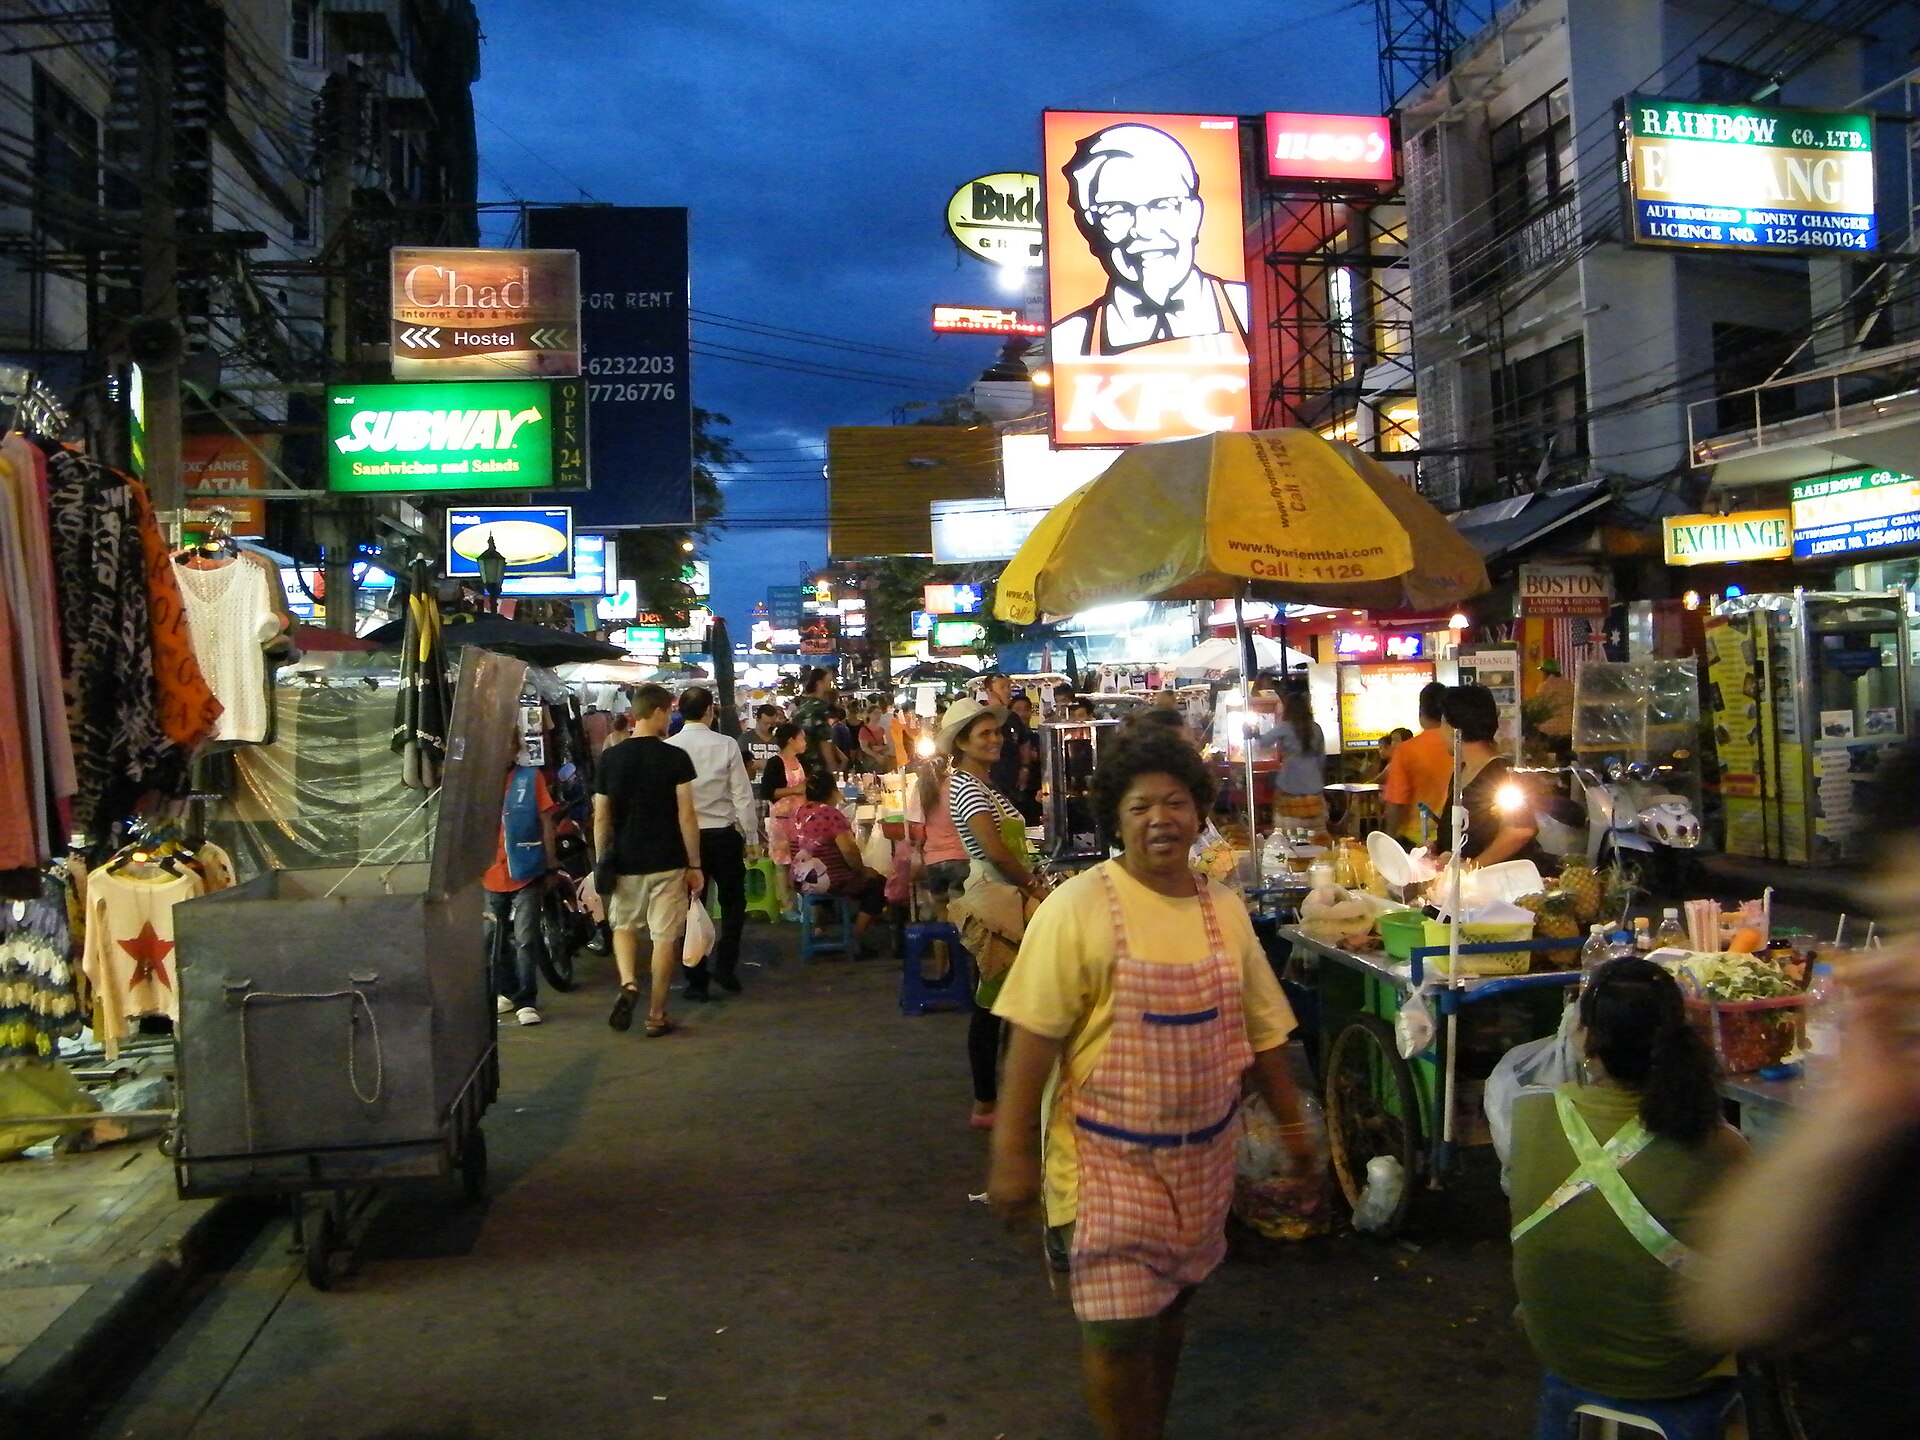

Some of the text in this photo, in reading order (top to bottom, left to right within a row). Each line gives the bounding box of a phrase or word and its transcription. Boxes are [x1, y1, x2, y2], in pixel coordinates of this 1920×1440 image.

[1640, 109, 1778, 143] RAINBOW
[1746, 210, 1797, 226] MONEY
[1801, 214, 1870, 231] CHANGER
[1650, 222, 1867, 249] LICENCE NO. 125480104
[404, 264, 530, 309] Chad
[625, 291, 674, 309] RENT
[401, 310, 451, 319] Internet
[457, 310, 485, 319] Cafe
[454, 331, 515, 346] Hostel
[589, 383, 676, 402] 7726776
[1062, 373, 1246, 432] KFC
[337, 407, 533, 453] SUBWAY
[352, 458, 519, 476] Sandwiches and Salads
[560, 448, 582, 469] 24
[1285, 484, 1306, 512] Call
[1672, 519, 1787, 555] EXCHANGE
[1228, 539, 1384, 561] www.flyorientthai.com
[1251, 559, 1290, 577] Call
[1313, 563, 1364, 579] 1126
[1525, 574, 1605, 595] BOSTON
